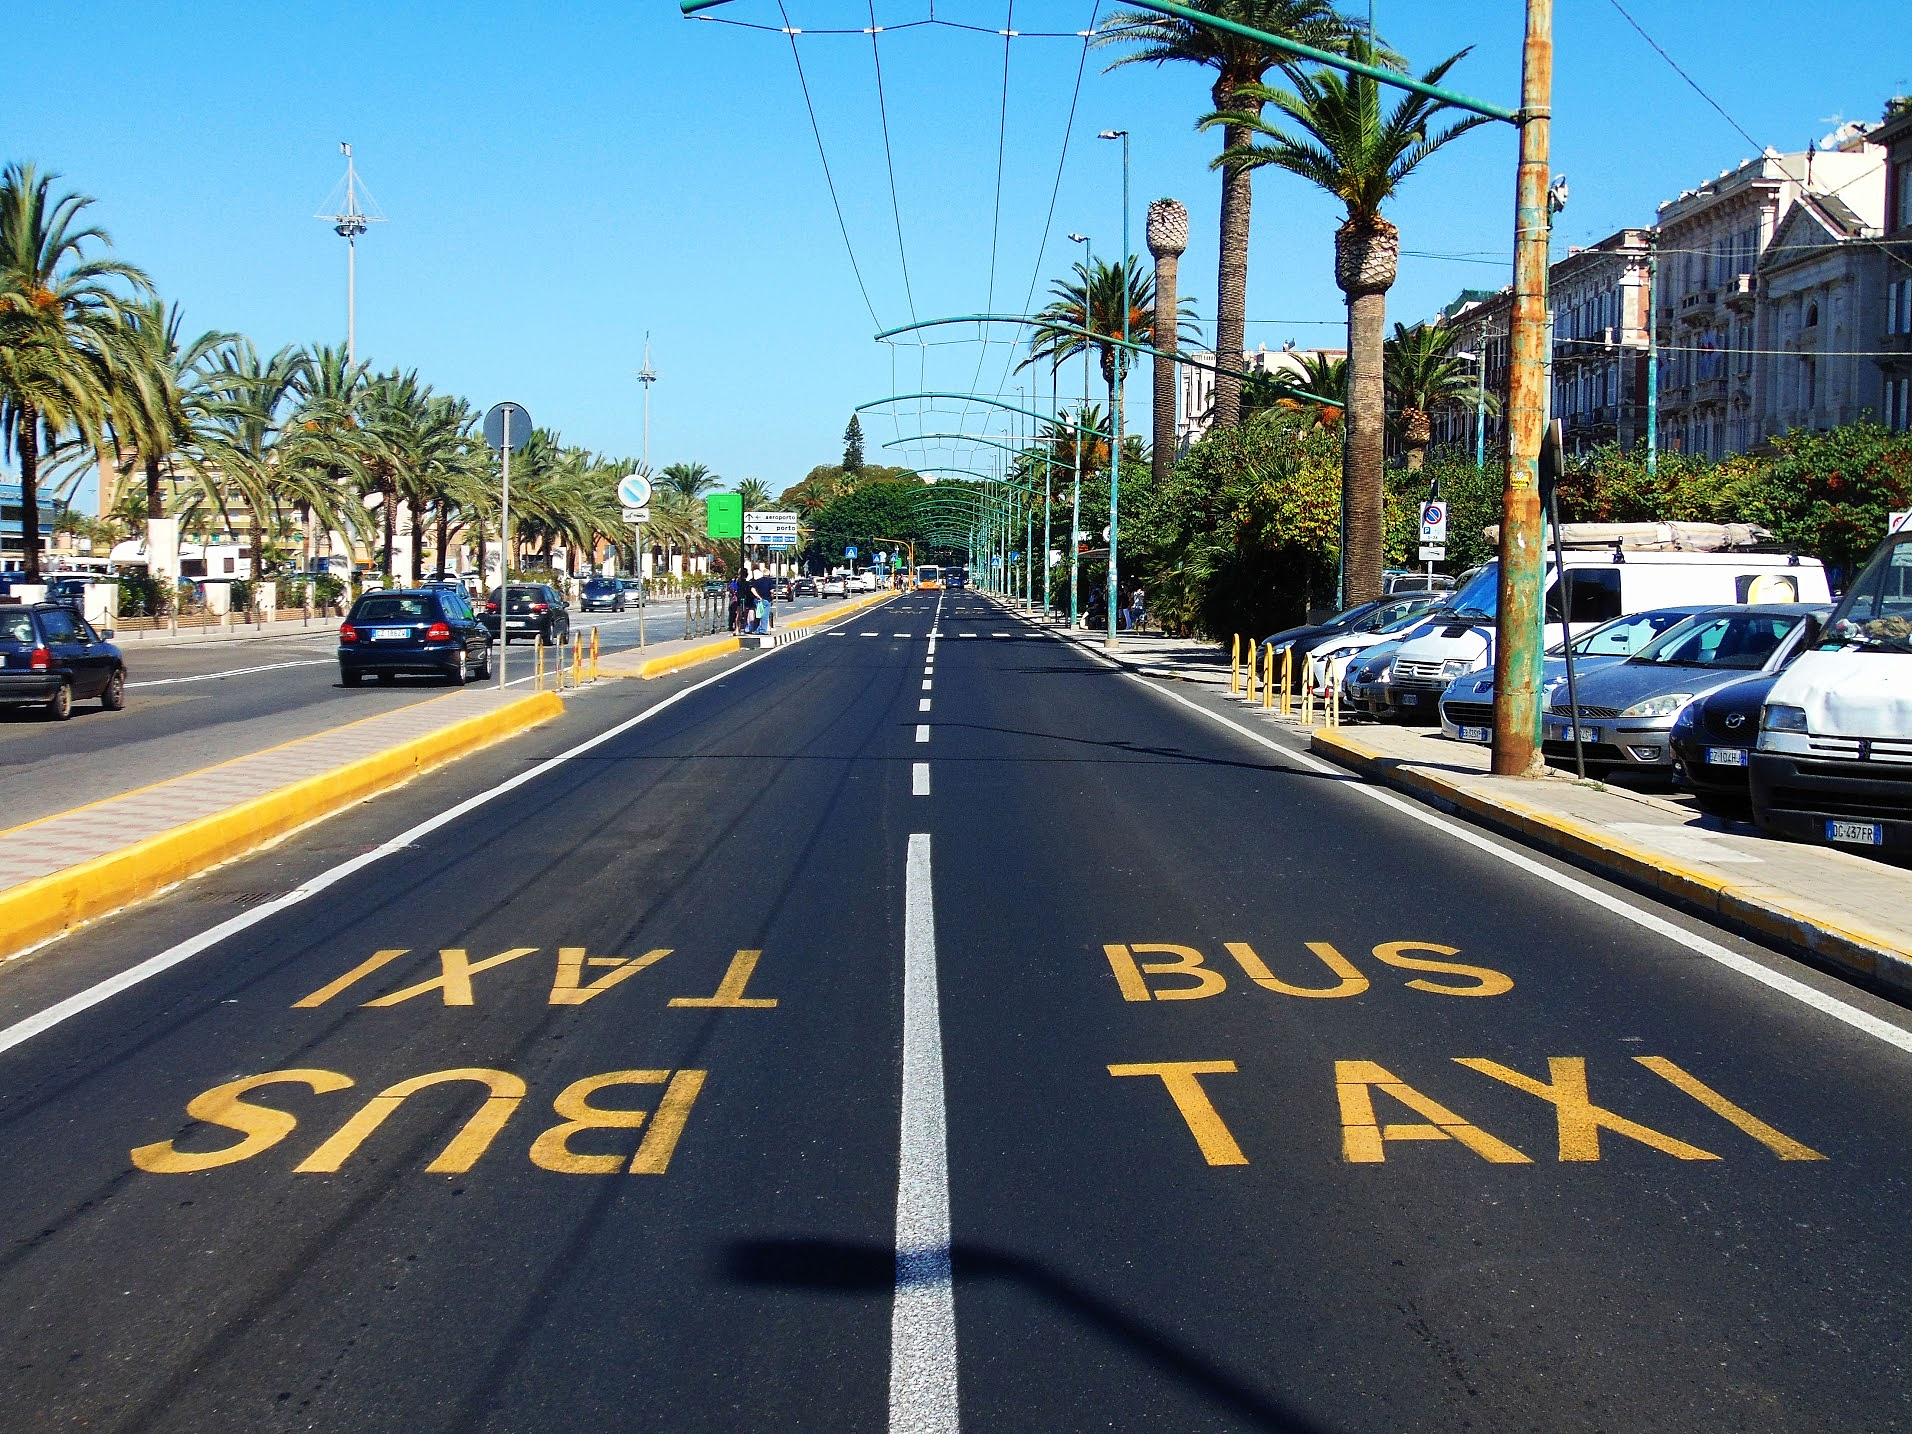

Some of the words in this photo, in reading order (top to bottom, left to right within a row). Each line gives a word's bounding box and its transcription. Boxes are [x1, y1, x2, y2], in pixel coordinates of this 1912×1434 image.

[294, 948, 779, 1010] TAXI
[1103, 942, 1515, 1003] BUS
[129, 1068, 708, 1176] BUS
[1107, 1056, 1828, 1168] TAXI
